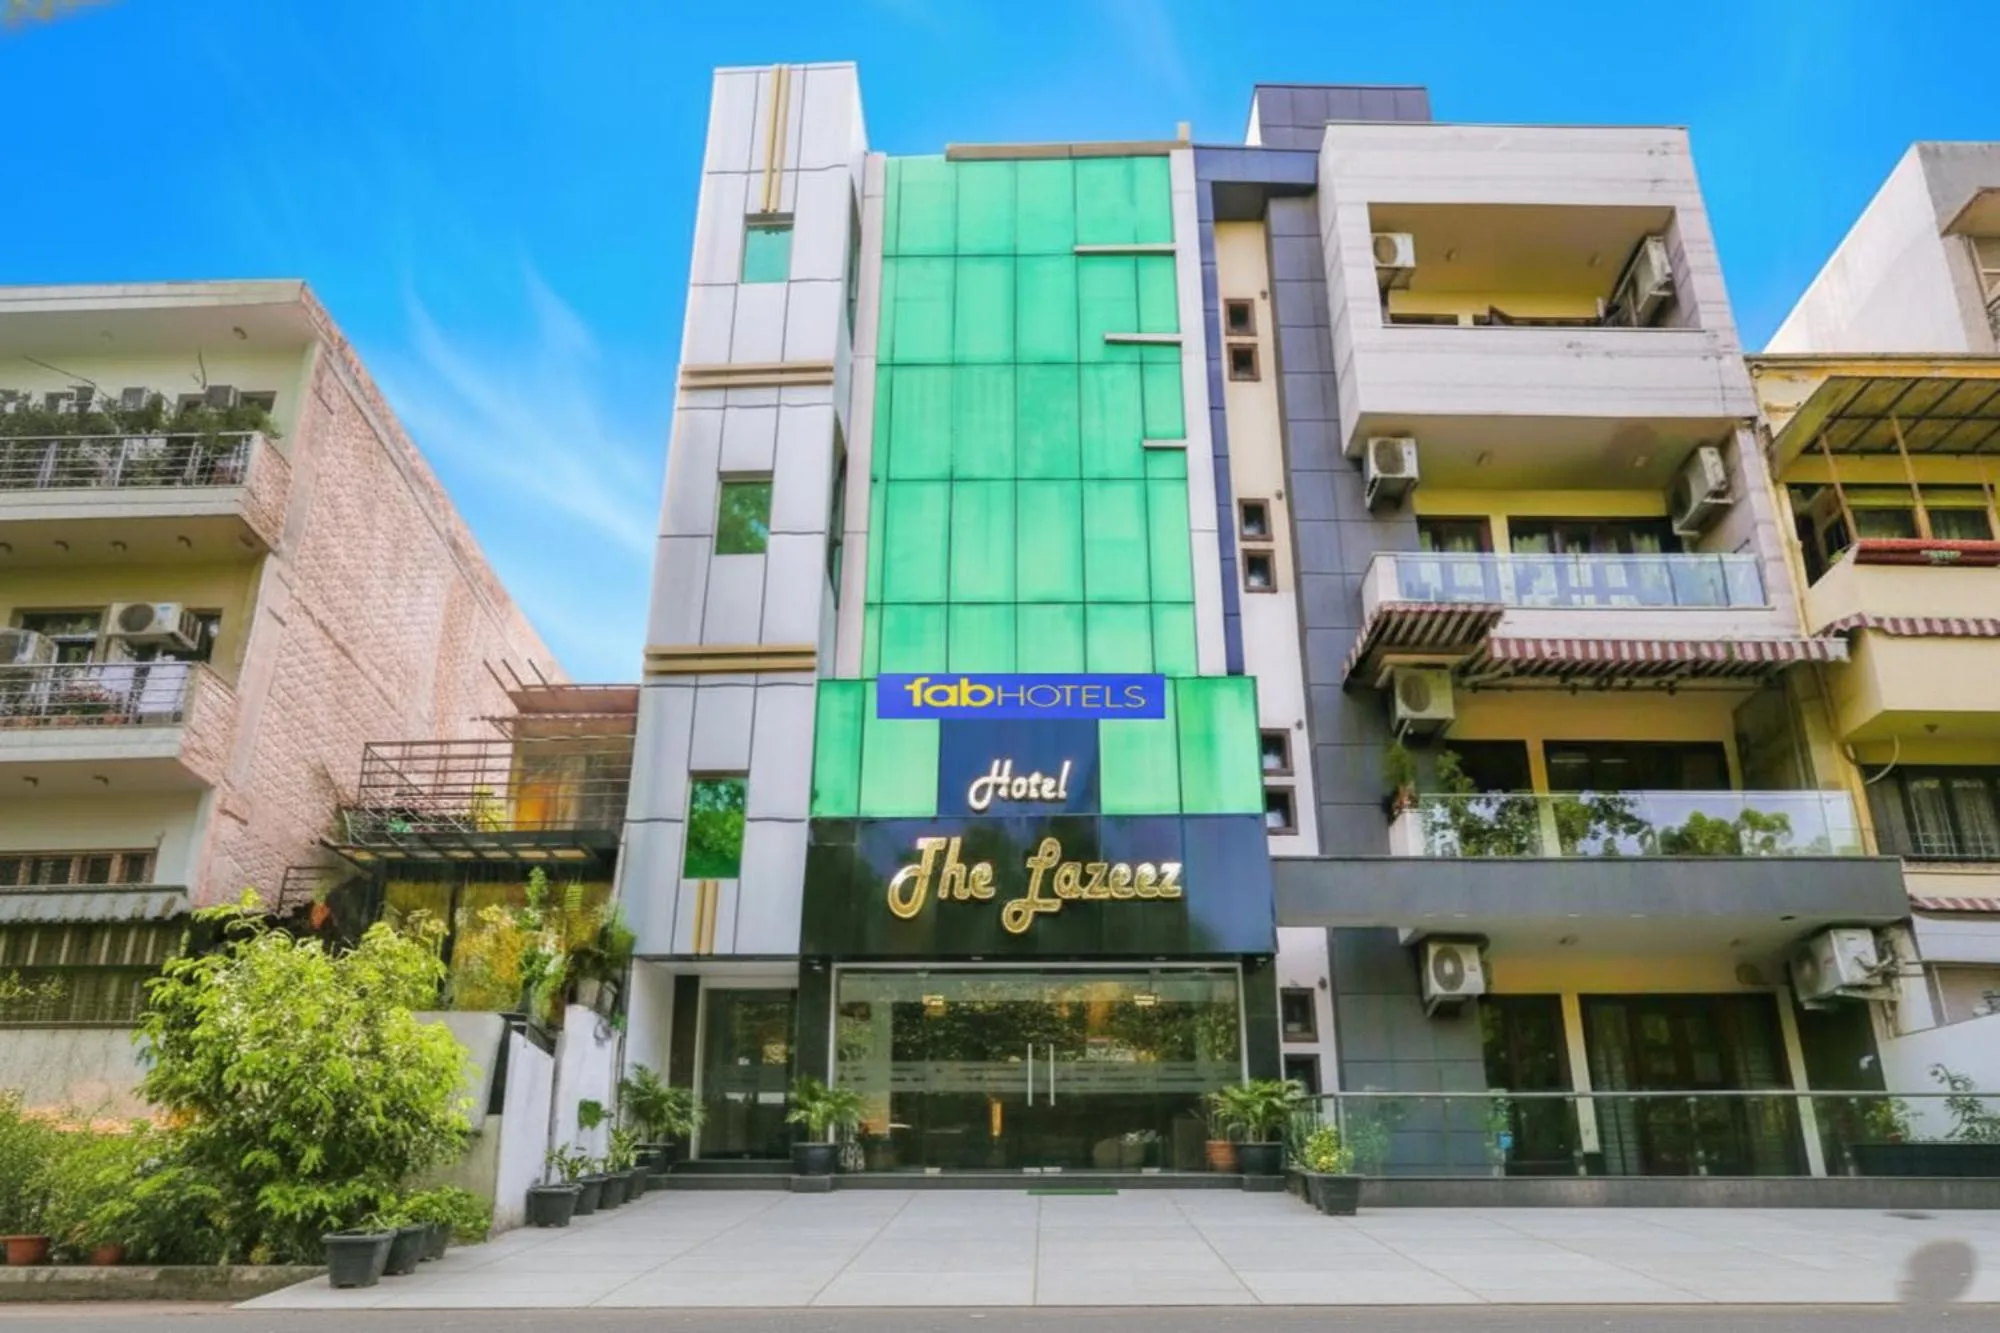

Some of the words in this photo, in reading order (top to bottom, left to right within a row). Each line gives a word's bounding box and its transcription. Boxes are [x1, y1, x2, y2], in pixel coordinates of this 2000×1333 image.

[967, 758, 1072, 811] Hotel
[887, 836, 995, 920] The
[1001, 836, 1183, 935] Lazeez
